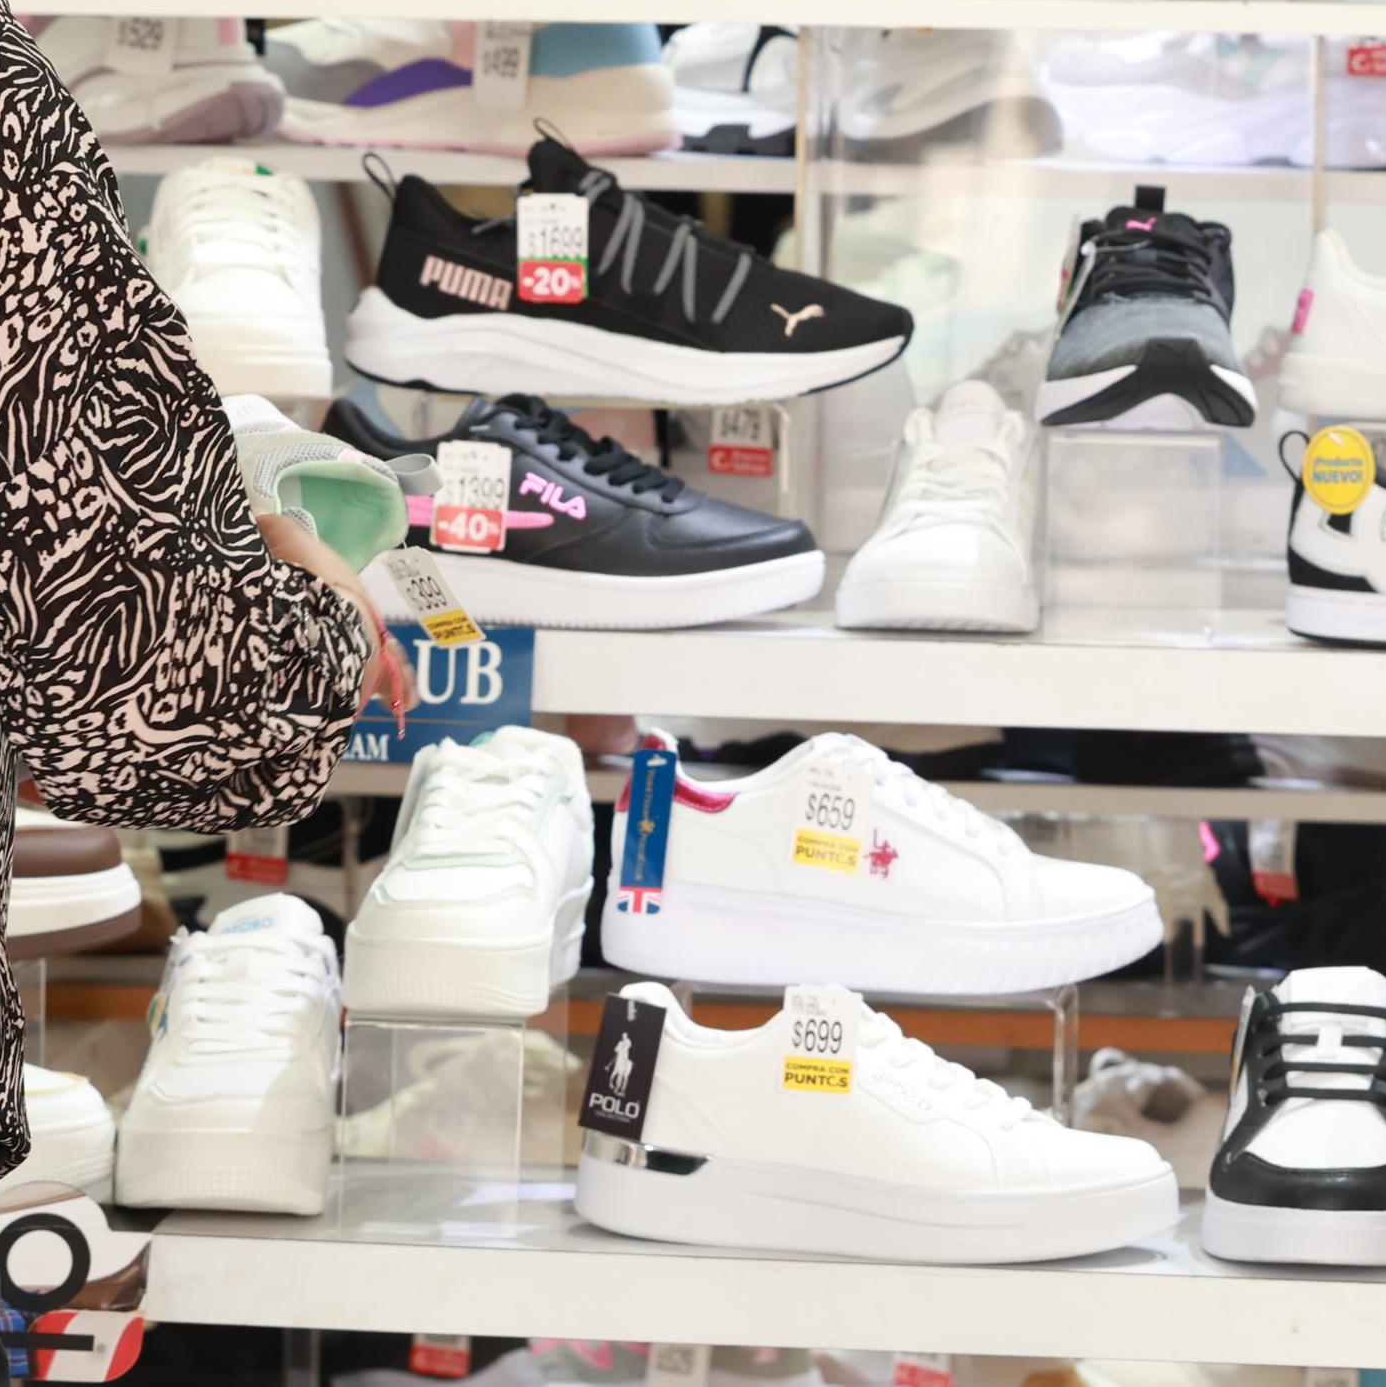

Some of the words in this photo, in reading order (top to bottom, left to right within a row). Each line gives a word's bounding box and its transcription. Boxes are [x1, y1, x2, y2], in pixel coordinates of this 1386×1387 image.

[418, 254, 514, 312] PUMA
[521, 266, 582, 297] -20%
[1312, 470, 1364, 484] NUEVO!
[519, 471, 587, 520] FILA
[437, 512, 500, 544] -40%
[406, 575, 448, 612] $399
[805, 792, 856, 832] $659
[791, 1018, 843, 1054] $699
[785, 1062, 826, 1073] COMPRA
[828, 1066, 850, 1075] CON
[588, 1092, 642, 1120] POLO
